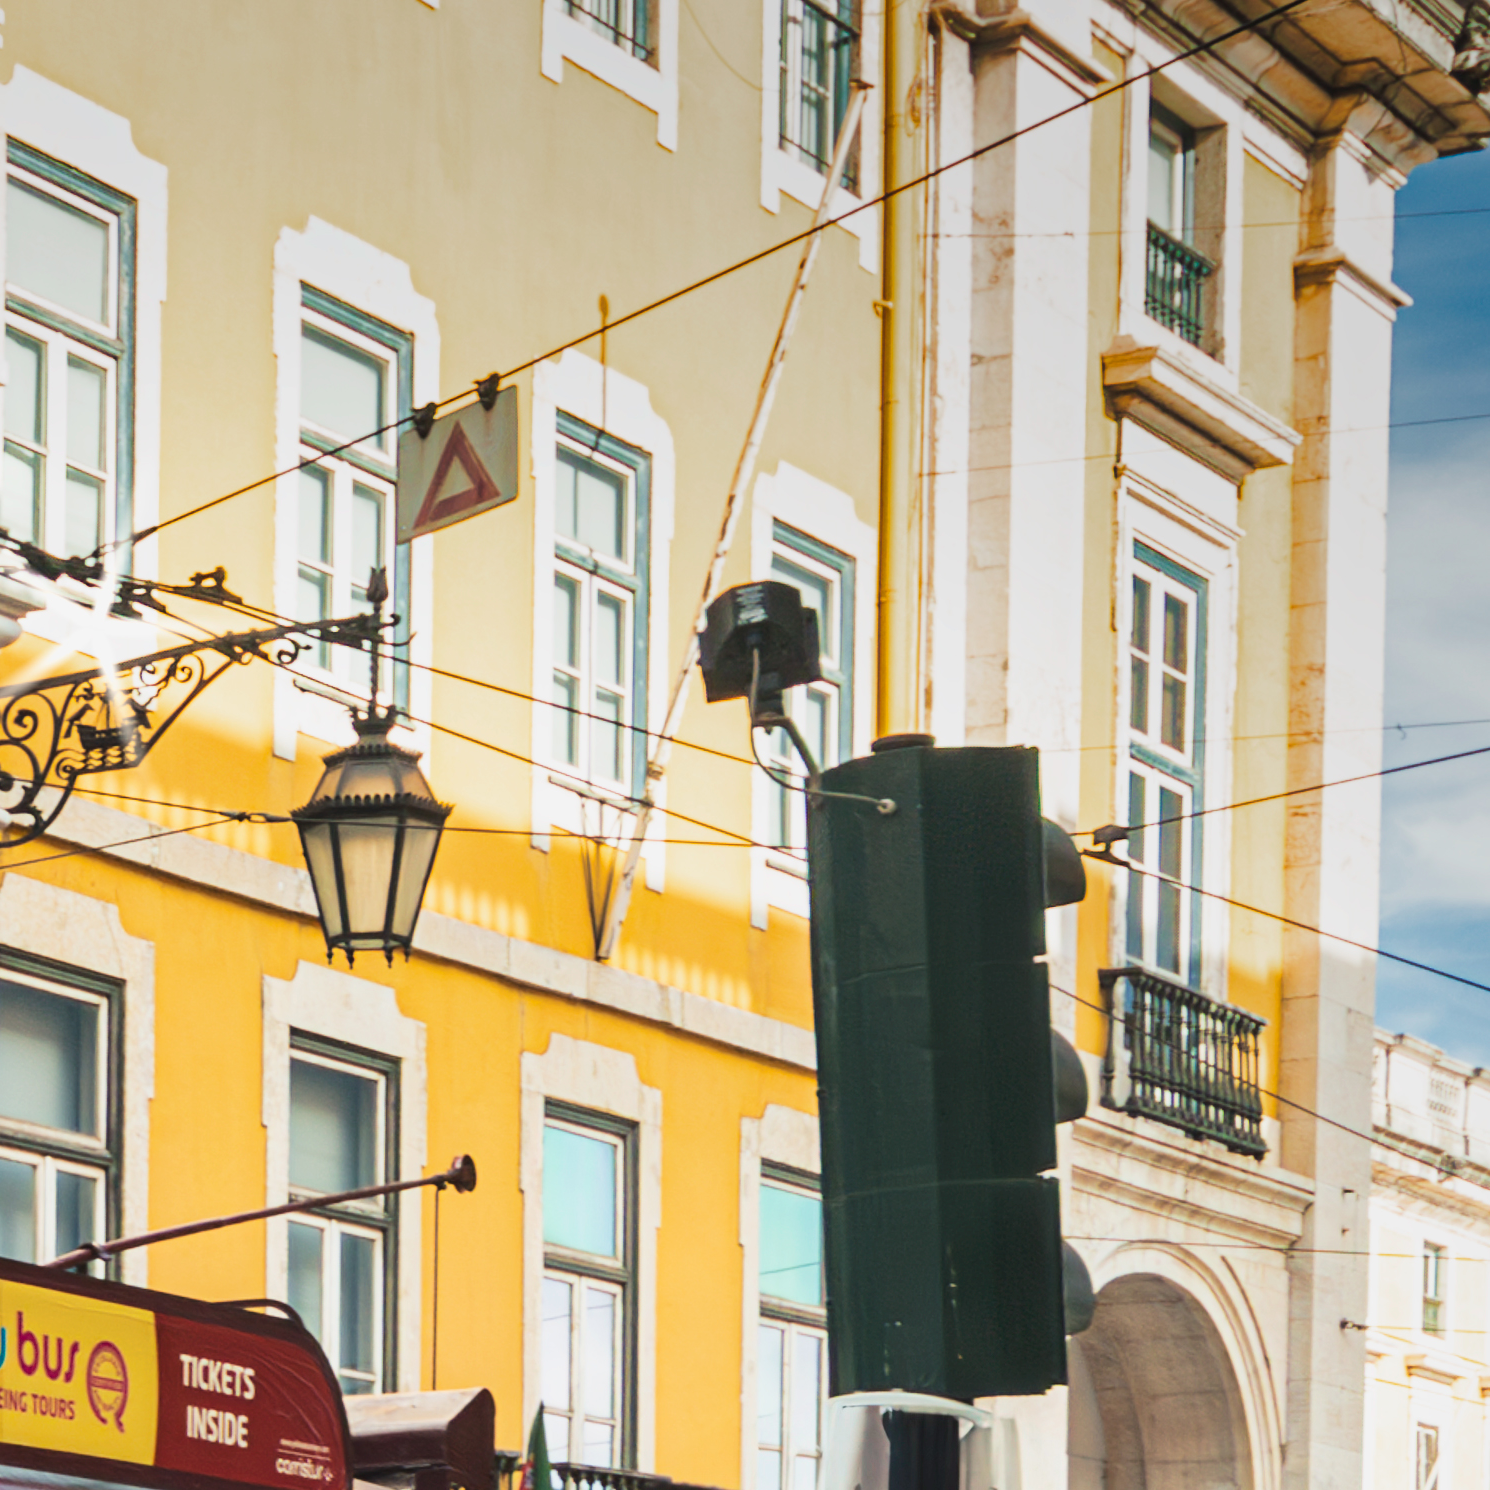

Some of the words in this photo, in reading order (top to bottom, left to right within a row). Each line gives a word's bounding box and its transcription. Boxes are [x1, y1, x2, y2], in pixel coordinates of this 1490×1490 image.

[17, 1310, 80, 1384] bus
[179, 1353, 256, 1400] TICKETS
[31, 1393, 76, 1420] TOURS
[186, 1404, 249, 1448] INSIDE
